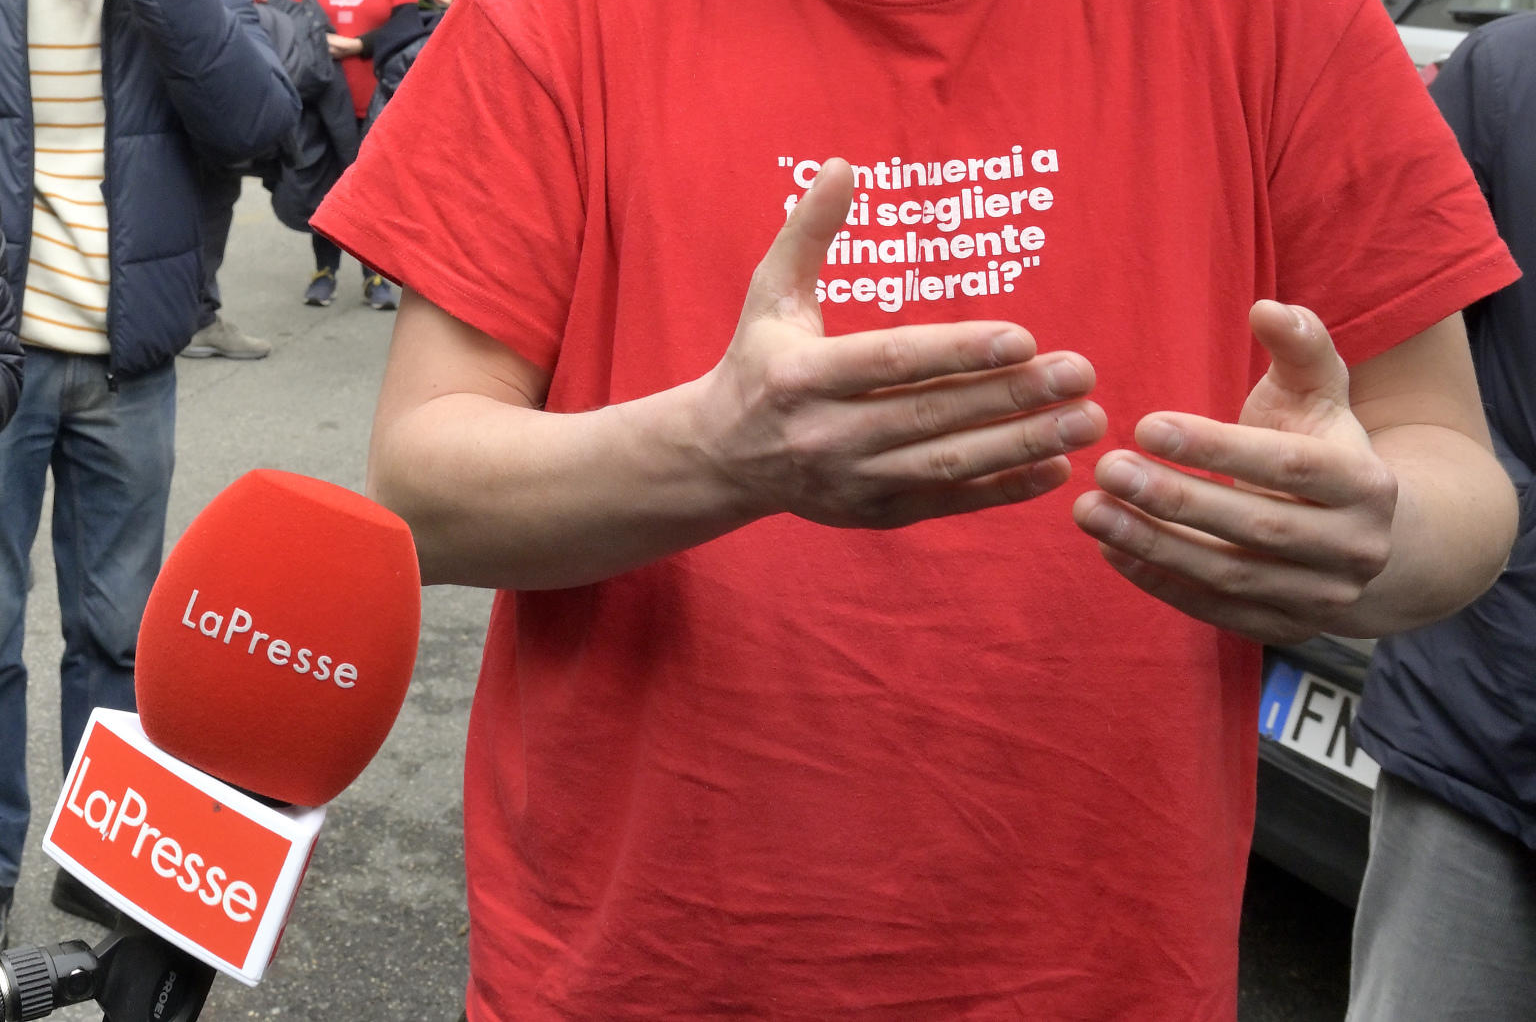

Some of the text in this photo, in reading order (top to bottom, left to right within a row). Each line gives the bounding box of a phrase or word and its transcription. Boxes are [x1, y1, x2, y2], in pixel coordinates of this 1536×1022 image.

[777, 145, 1060, 190] "Cntinuerai a
[783, 185, 1054, 233] fti scegliere
[826, 225, 1046, 266] finalmente
[814, 255, 1041, 314] sceglierai?"
[181, 589, 359, 689] LaPresse
[66, 755, 258, 923] LaPresse
